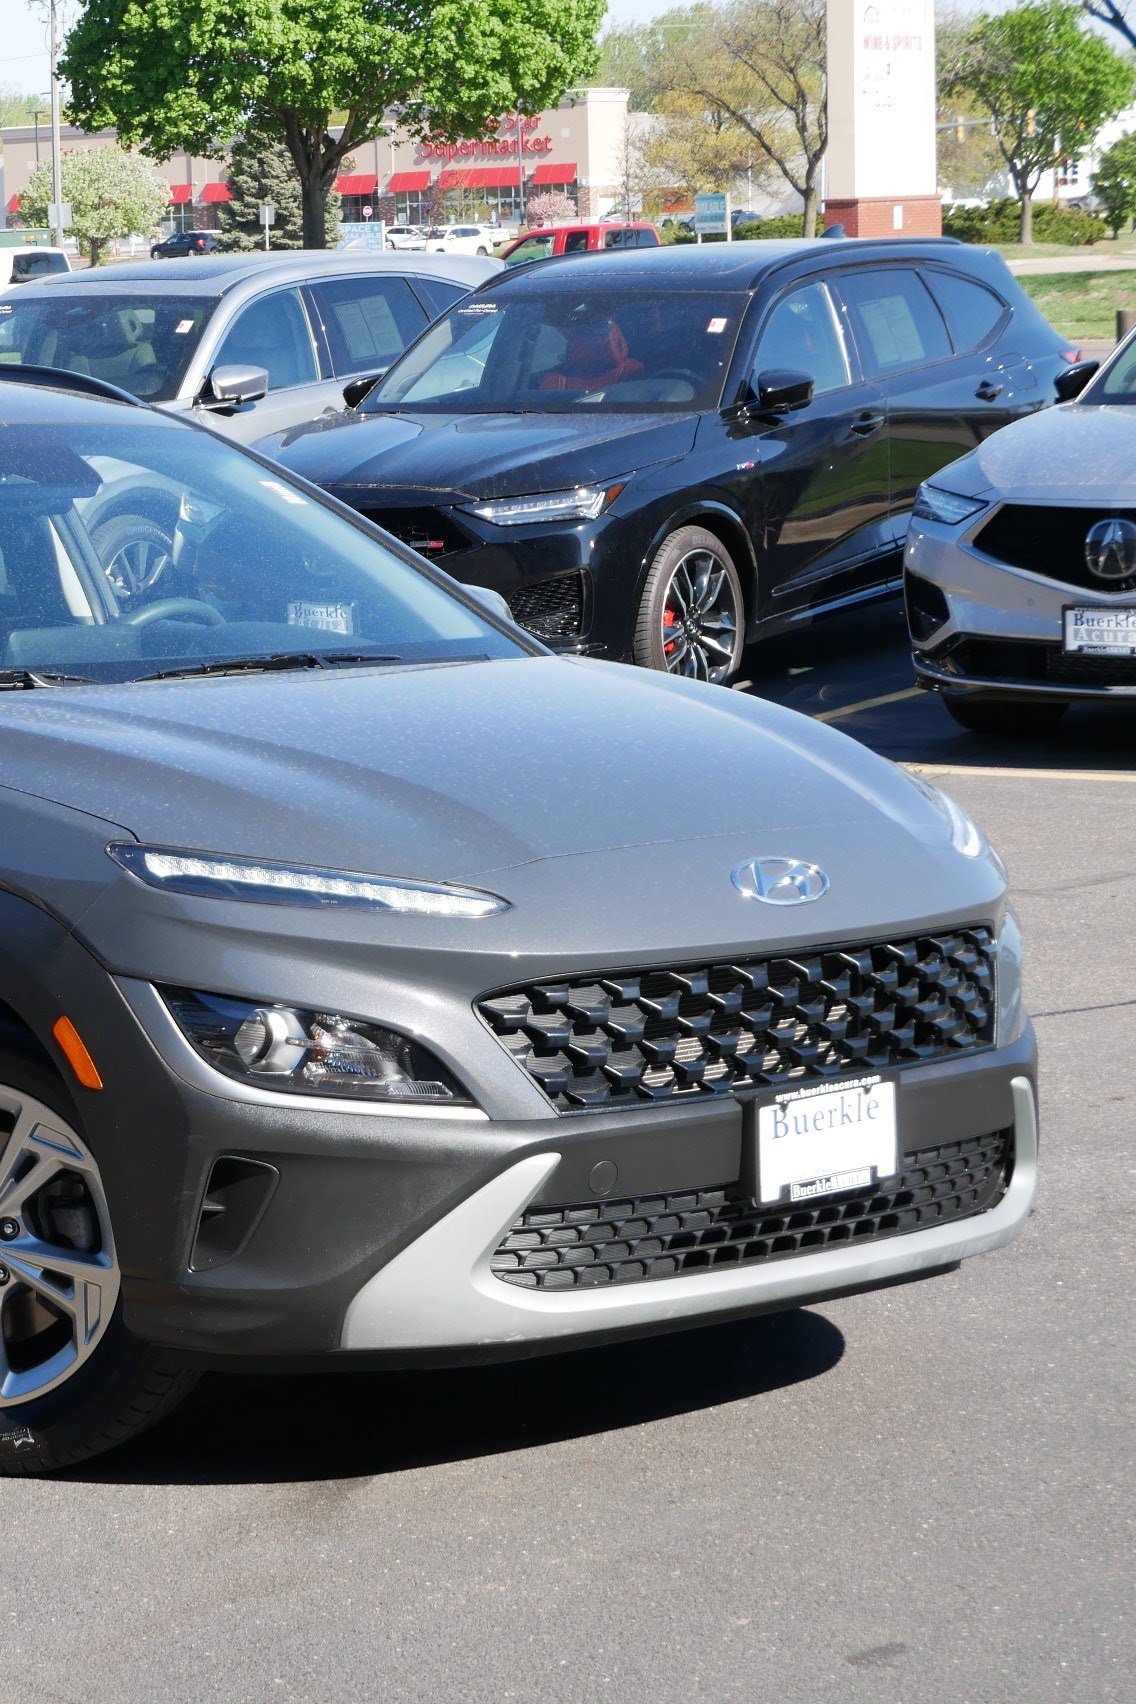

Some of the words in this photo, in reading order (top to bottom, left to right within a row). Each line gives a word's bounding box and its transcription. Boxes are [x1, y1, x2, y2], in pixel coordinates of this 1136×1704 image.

[419, 132, 553, 162] Supermarket
[343, 233, 382, 241] VAILABLE
[294, 602, 347, 619] Buerkle
[775, 1074, 882, 1103] www.buerkleacura.com
[771, 1092, 880, 1140] Buerkle
[792, 1176, 832, 1199] Buerkle
